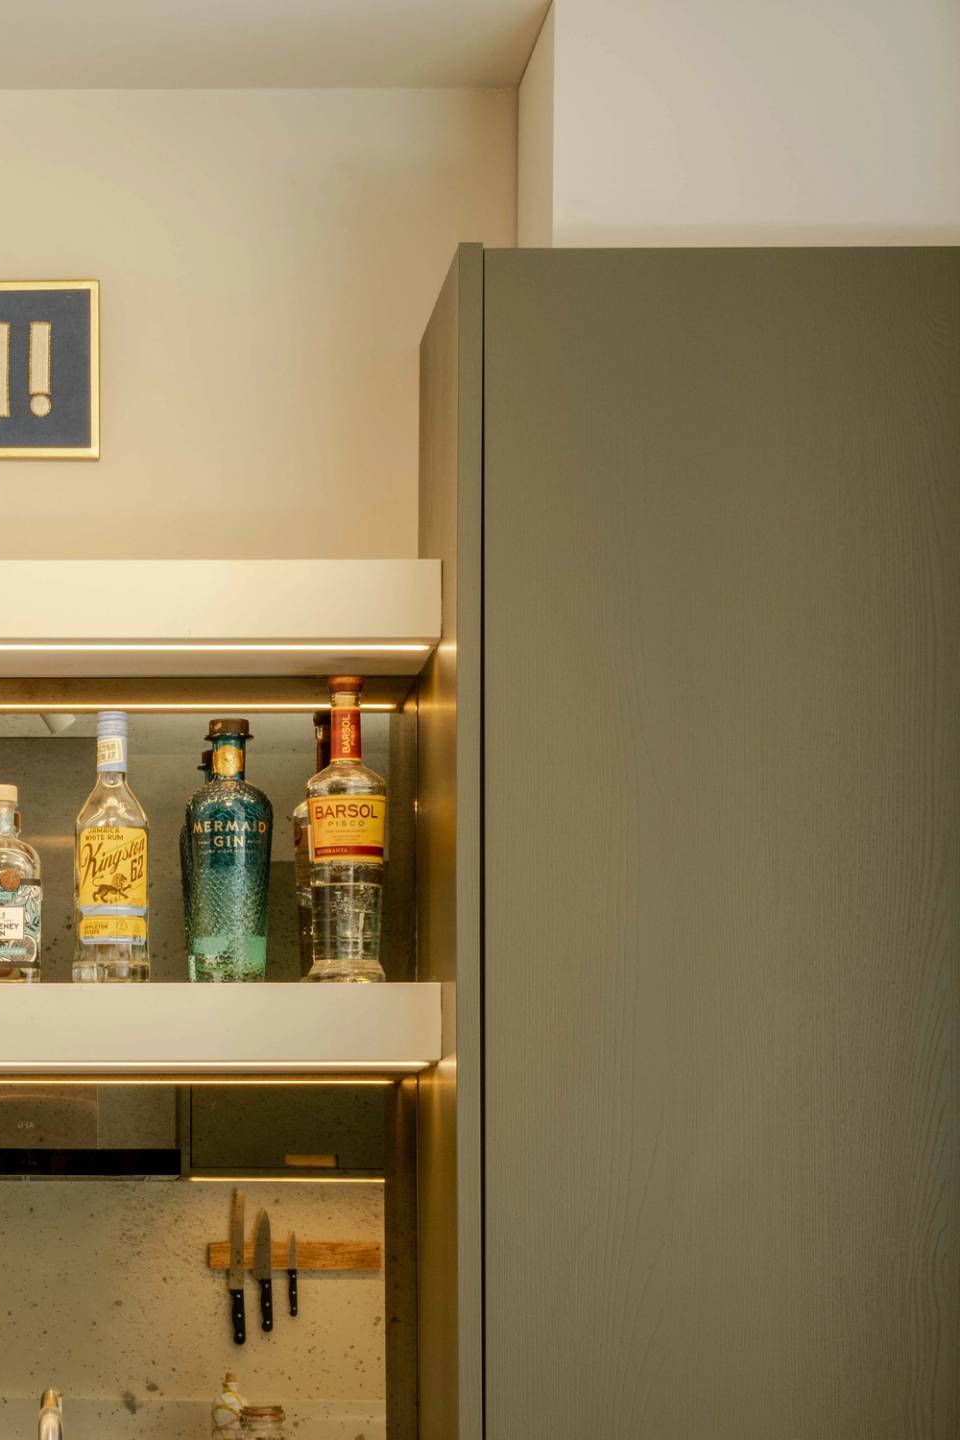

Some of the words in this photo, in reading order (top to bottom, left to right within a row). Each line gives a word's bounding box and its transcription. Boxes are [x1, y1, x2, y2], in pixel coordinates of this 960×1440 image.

[342, 713, 351, 754] BARSOL
[315, 803, 378, 820] BARSOL
[88, 826, 120, 834] JAMAICA
[193, 820, 266, 833] MERMAID
[214, 835, 244, 847] GIN
[81, 837, 145, 889] Kingston
[130, 855, 144, 883] 62
